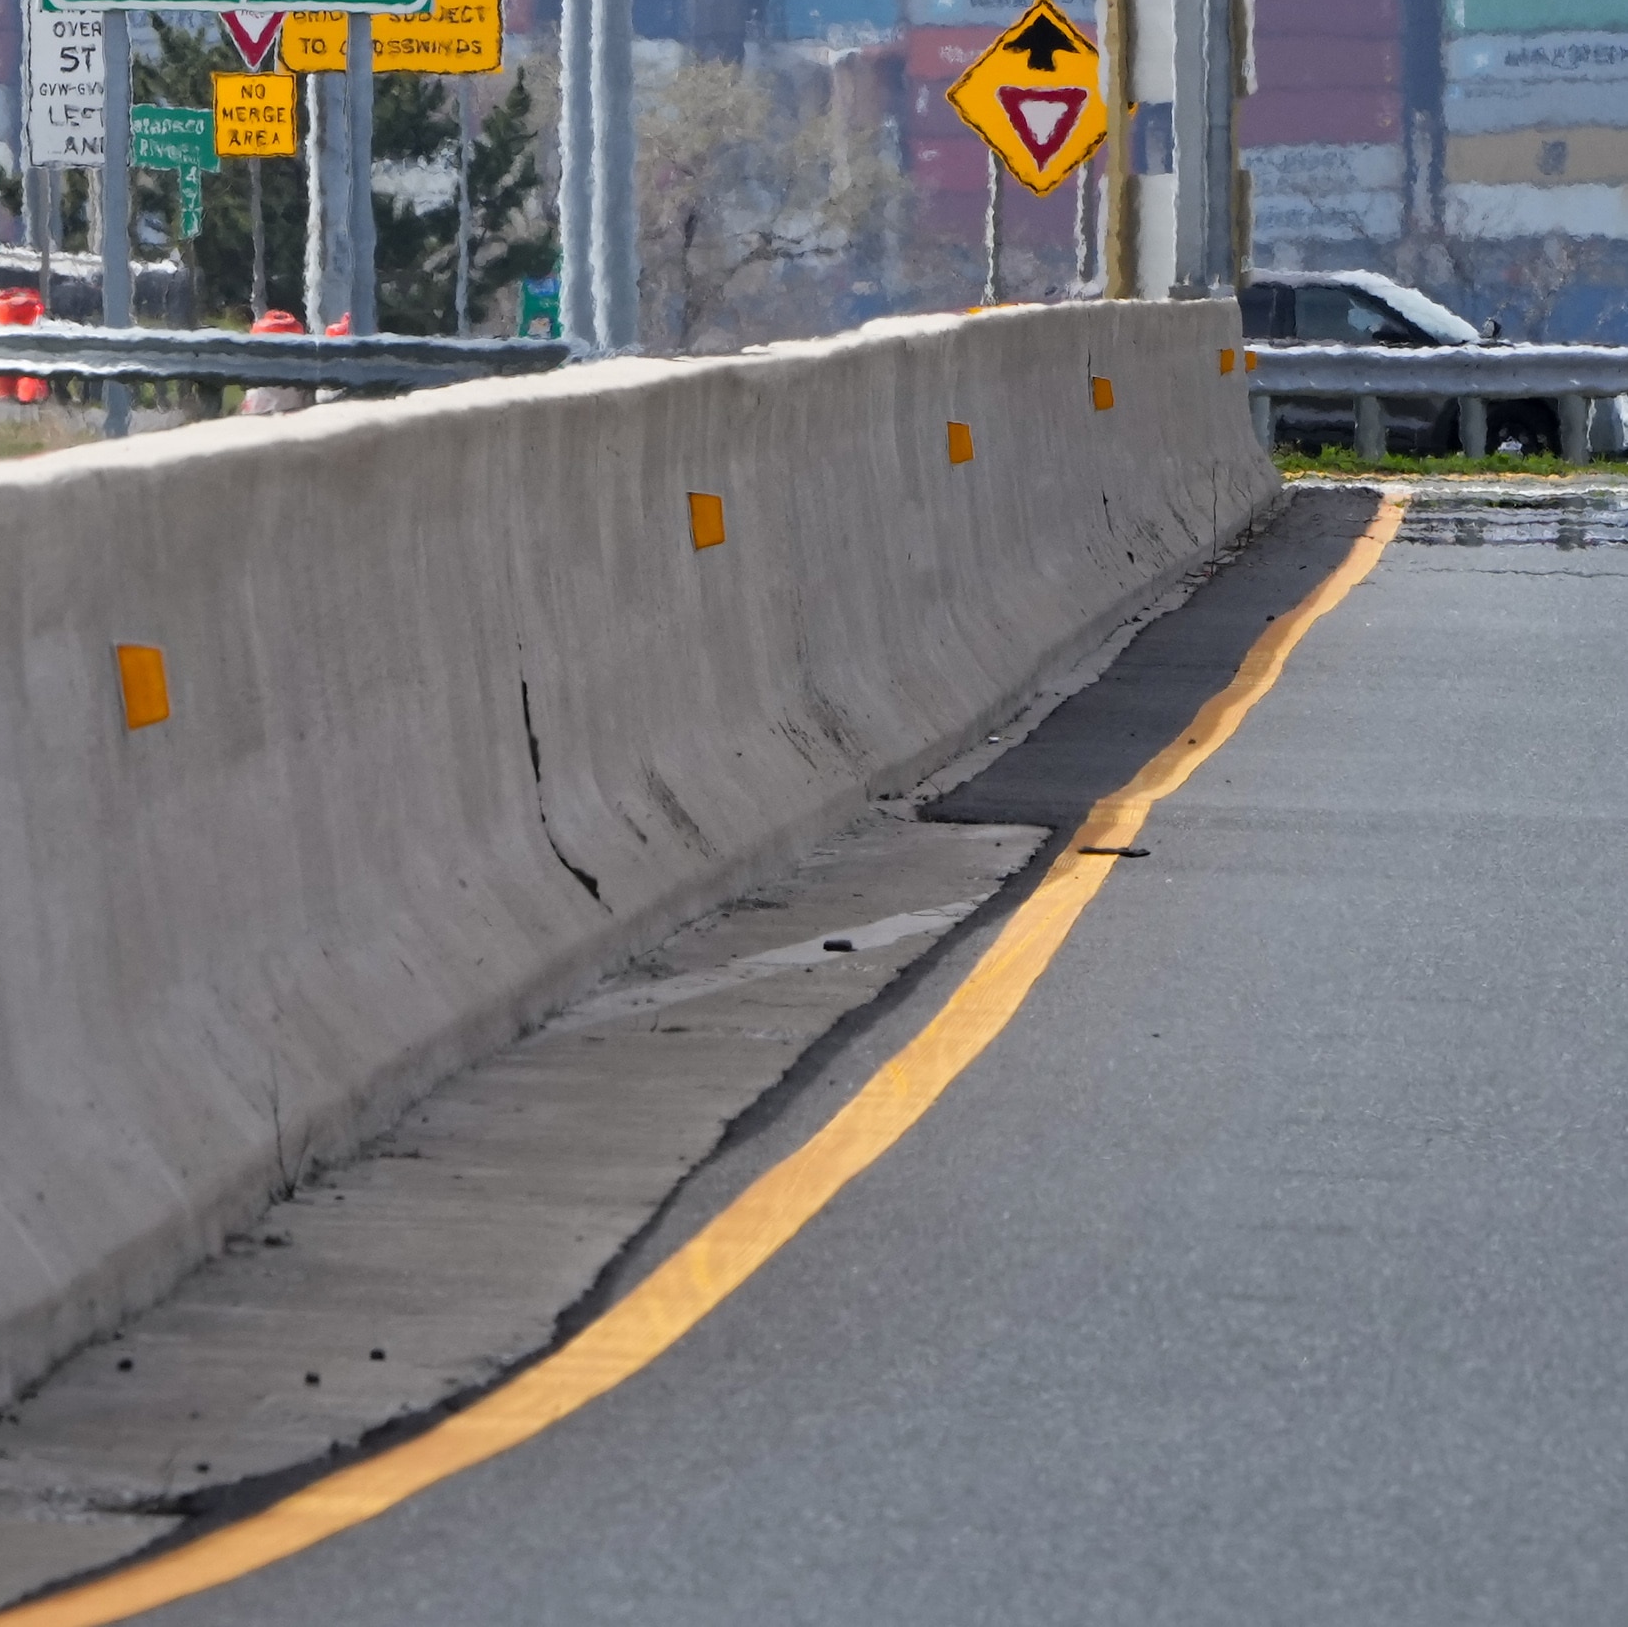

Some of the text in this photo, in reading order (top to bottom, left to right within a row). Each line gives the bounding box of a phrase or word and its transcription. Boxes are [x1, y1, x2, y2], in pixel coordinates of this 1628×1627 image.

[53, 21, 102, 37] OVER
[299, 38, 326, 55] TO
[60, 46, 96, 73] 5T
[241, 84, 266, 100] NO
[222, 106, 286, 123] MERGE
[229, 130, 280, 146] AREA
